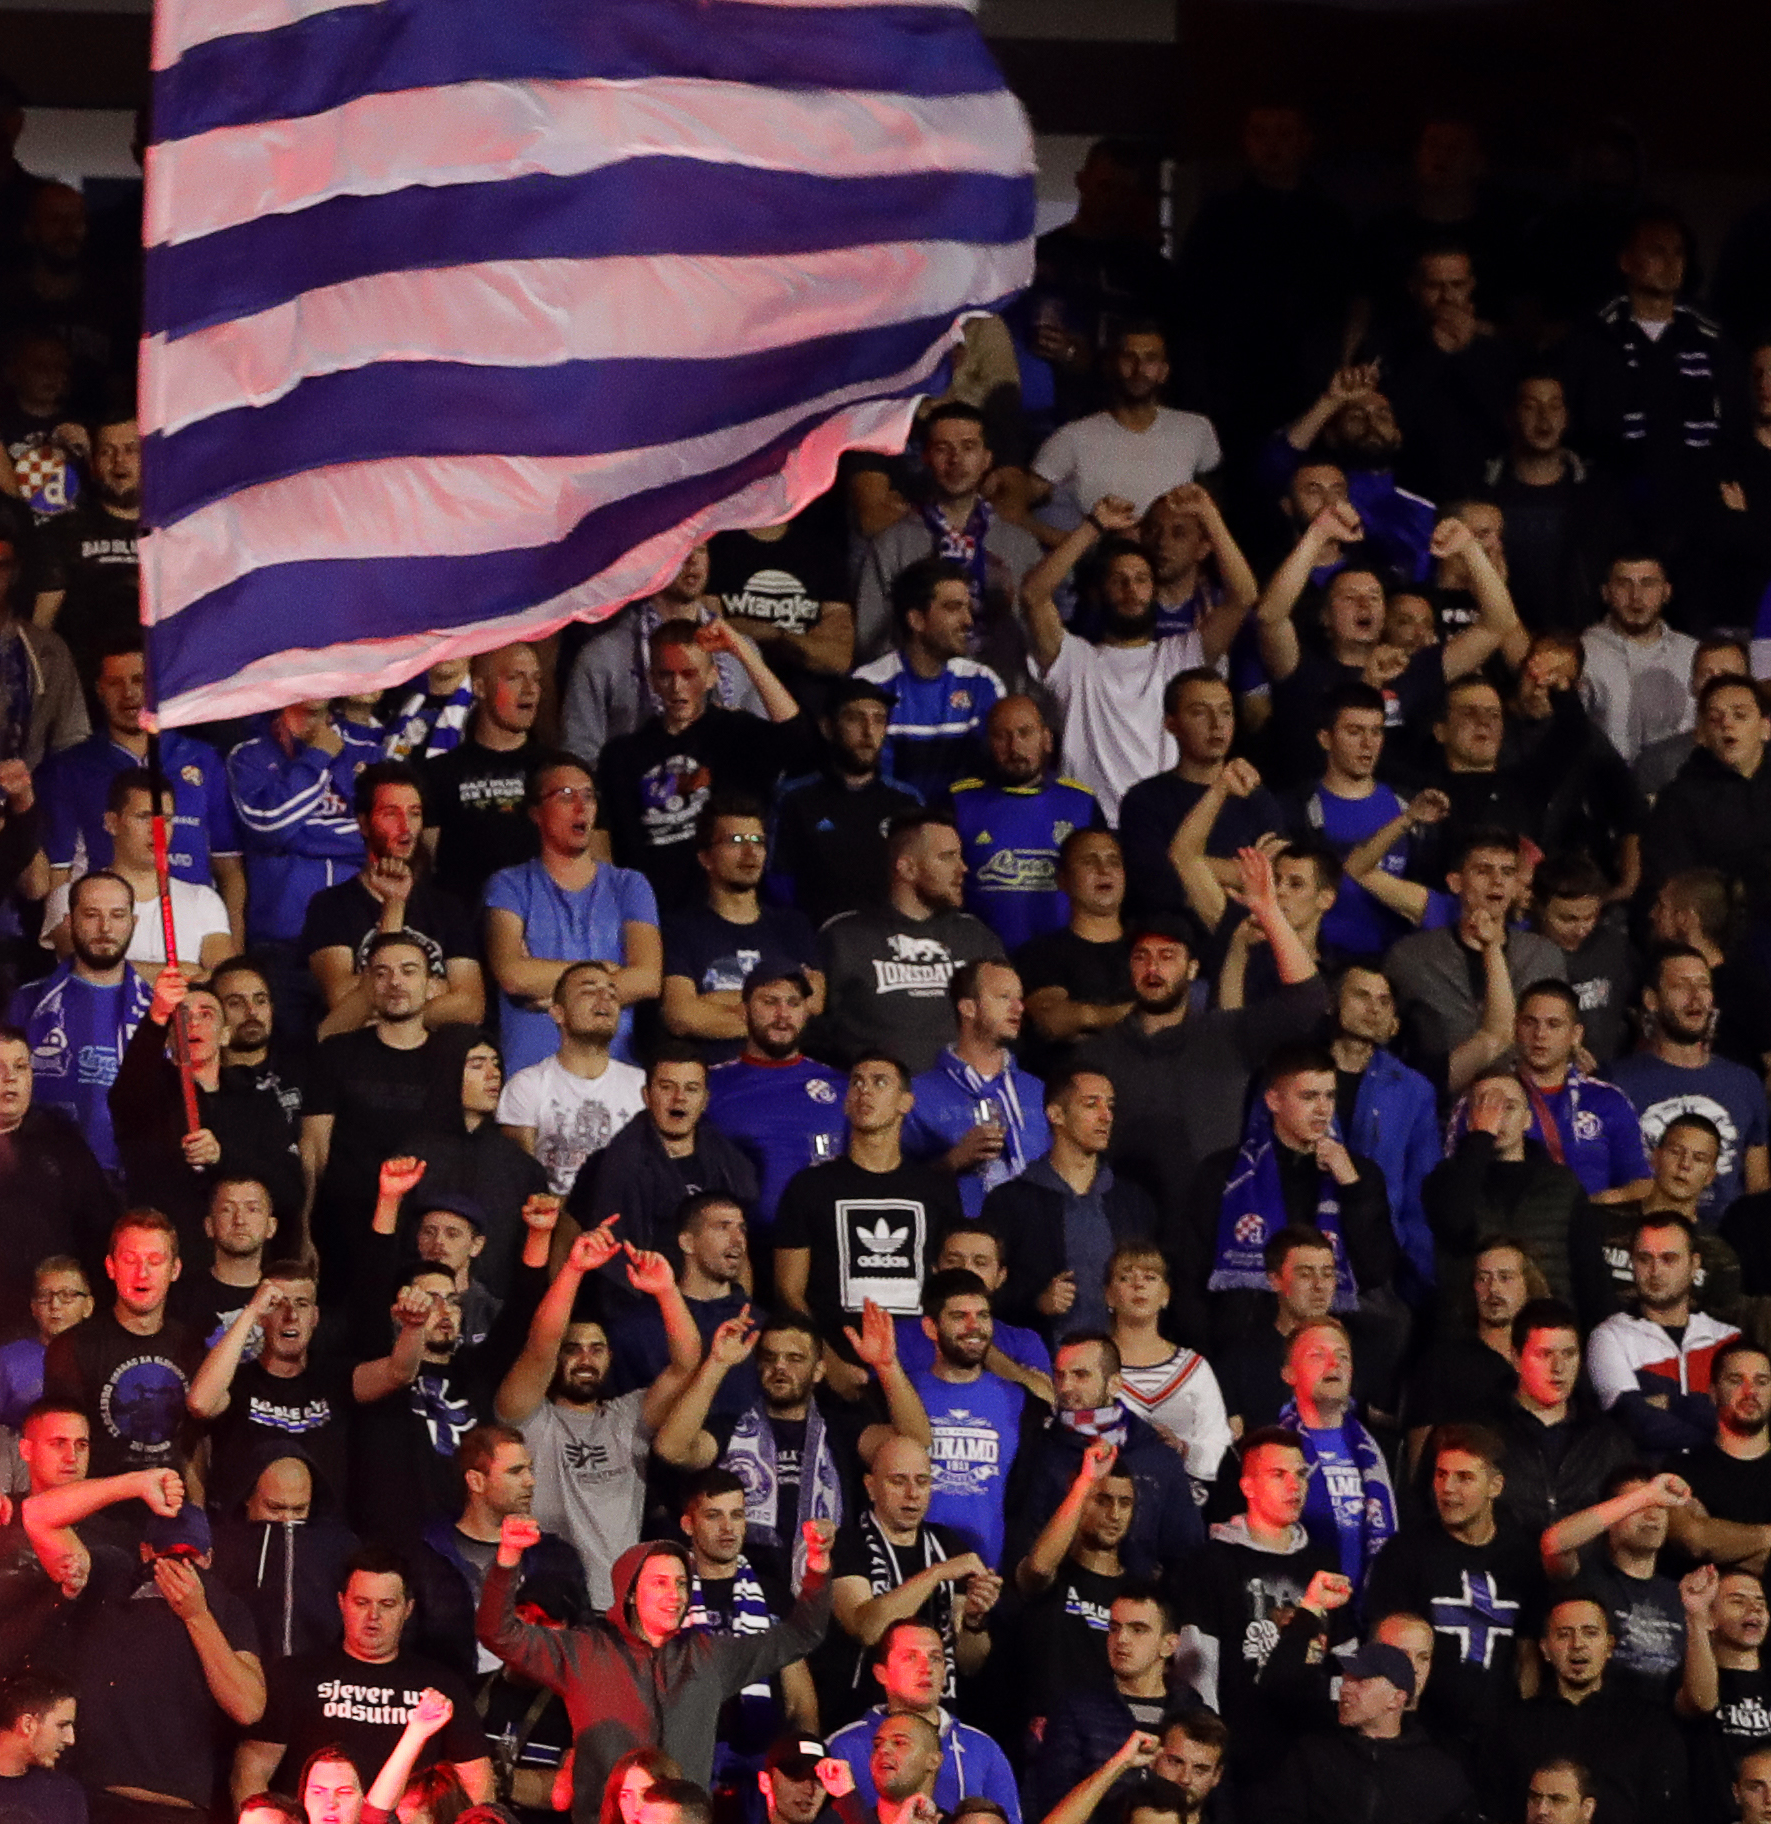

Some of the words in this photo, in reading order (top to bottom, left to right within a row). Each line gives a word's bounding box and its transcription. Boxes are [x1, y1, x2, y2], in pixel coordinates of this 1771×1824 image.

[721, 590, 820, 635] Wrangler
[873, 959, 956, 994] LONSDA
[856, 1254, 910, 1268] adidas
[317, 1679, 394, 1707] sjever
